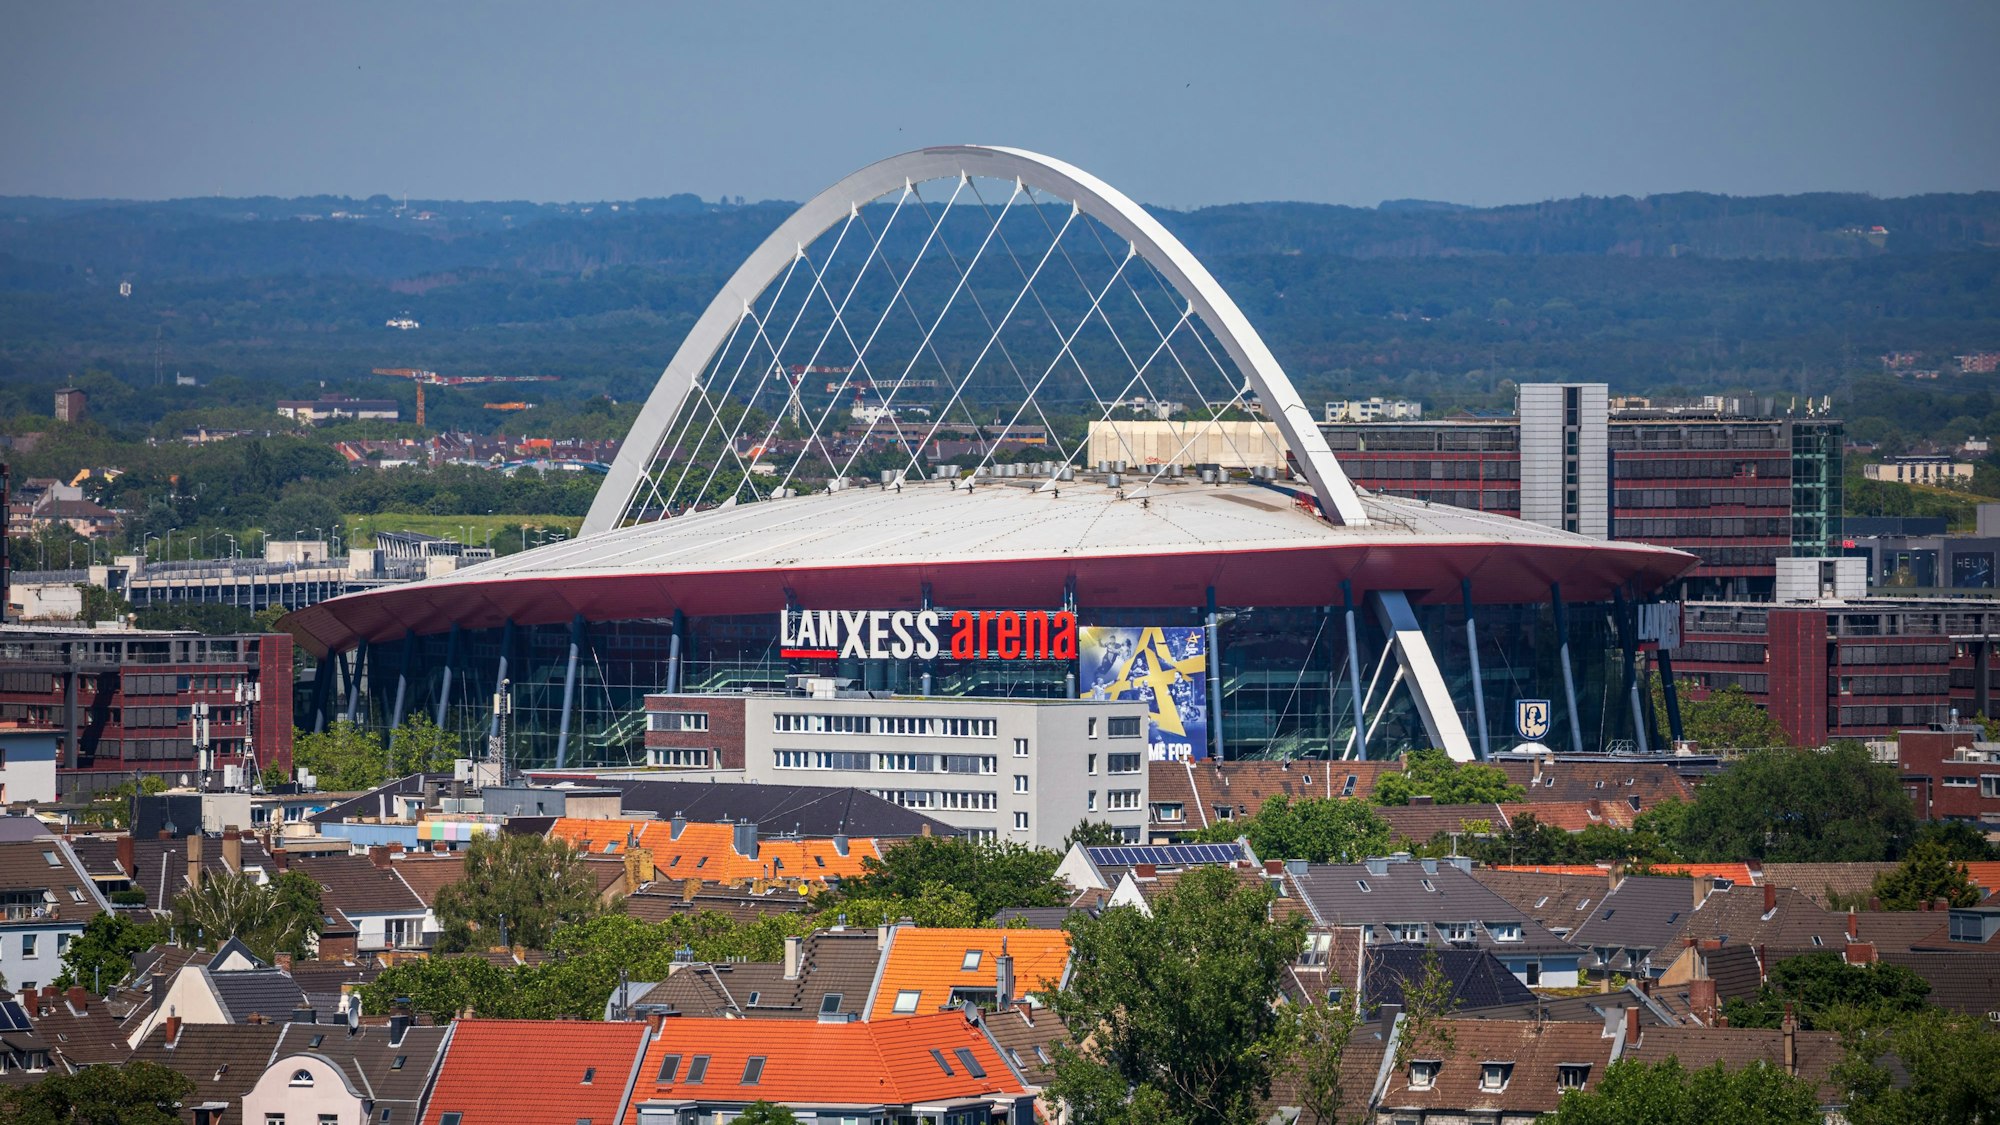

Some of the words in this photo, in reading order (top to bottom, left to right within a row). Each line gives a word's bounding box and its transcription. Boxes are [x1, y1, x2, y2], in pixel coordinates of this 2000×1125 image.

[1956, 558, 1990, 568] HELIX
[780, 610, 939, 660] LANXESS
[951, 609, 1078, 660] arena
[1168, 743, 1192, 762] FOR
